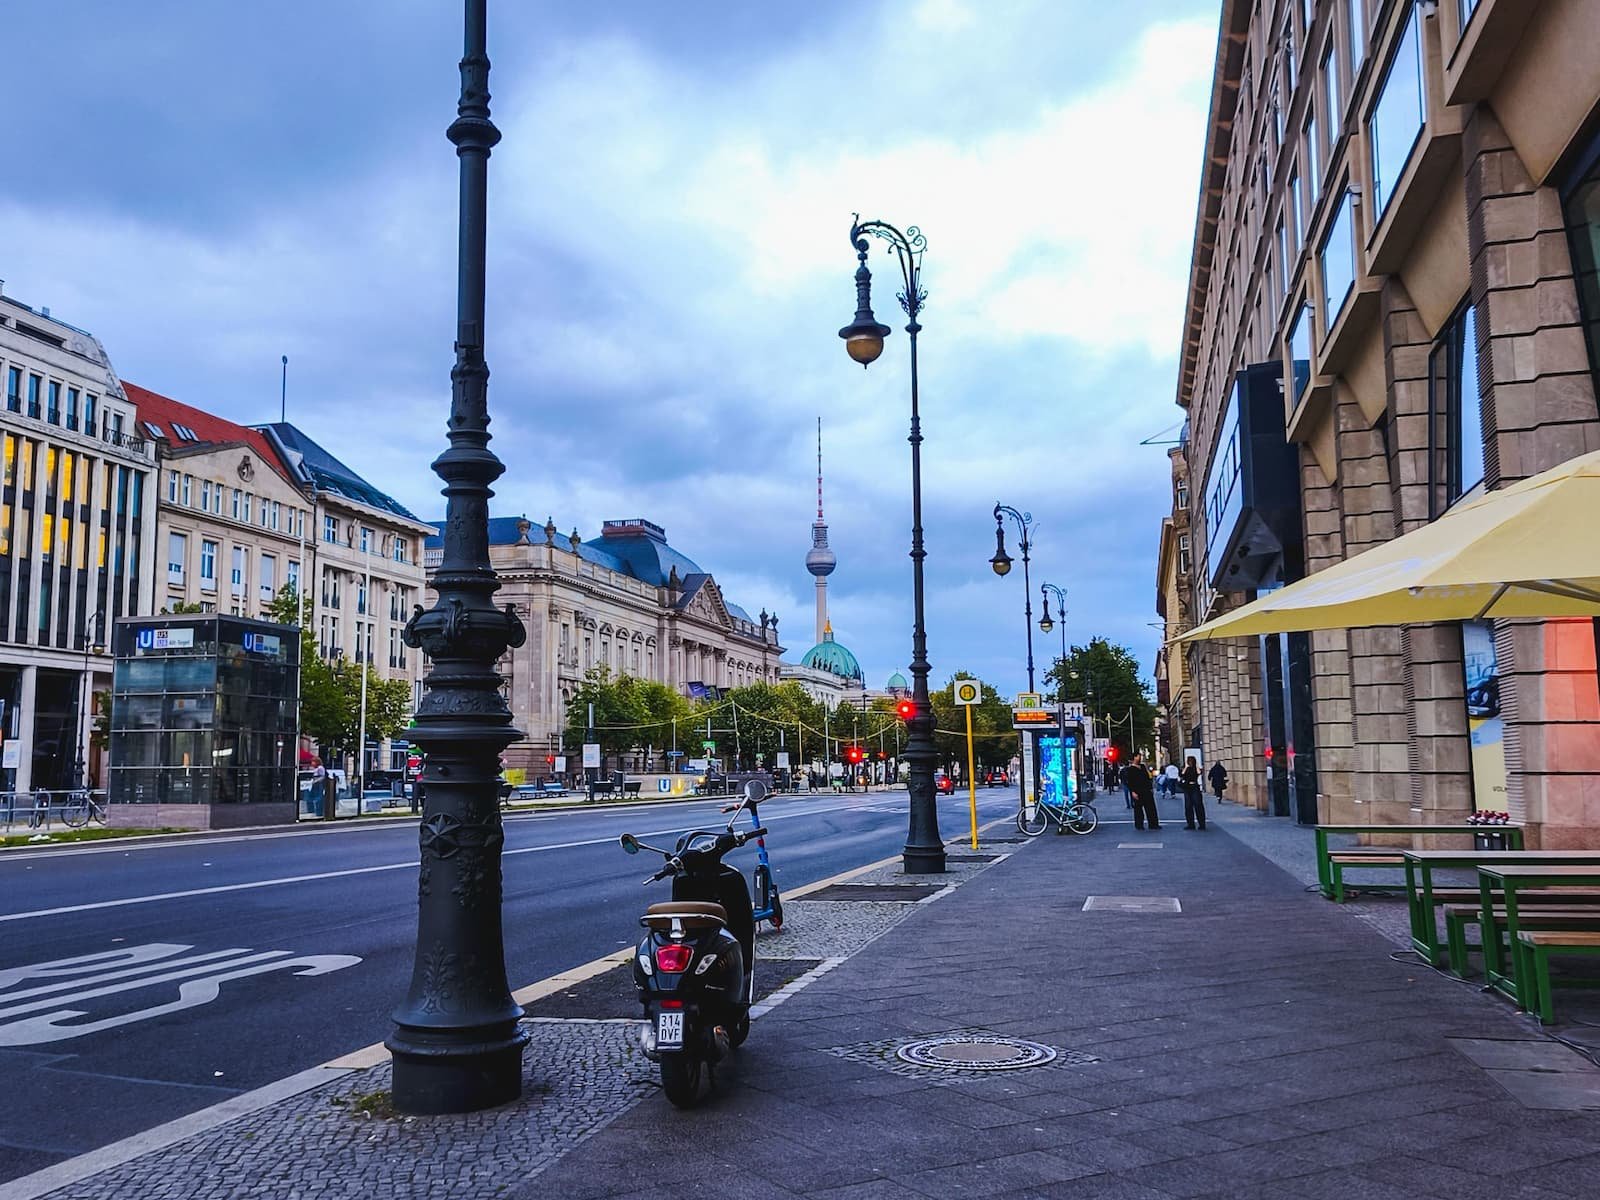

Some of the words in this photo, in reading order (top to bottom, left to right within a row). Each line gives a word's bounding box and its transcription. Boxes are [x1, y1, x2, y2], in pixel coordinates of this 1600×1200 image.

[140, 631, 152, 648] U
[244, 633, 253, 649] U
[963, 687, 972, 698] H
[659, 779, 670, 792] U
[661, 1015, 680, 1027] 314
[661, 1028, 680, 1041] DVF
